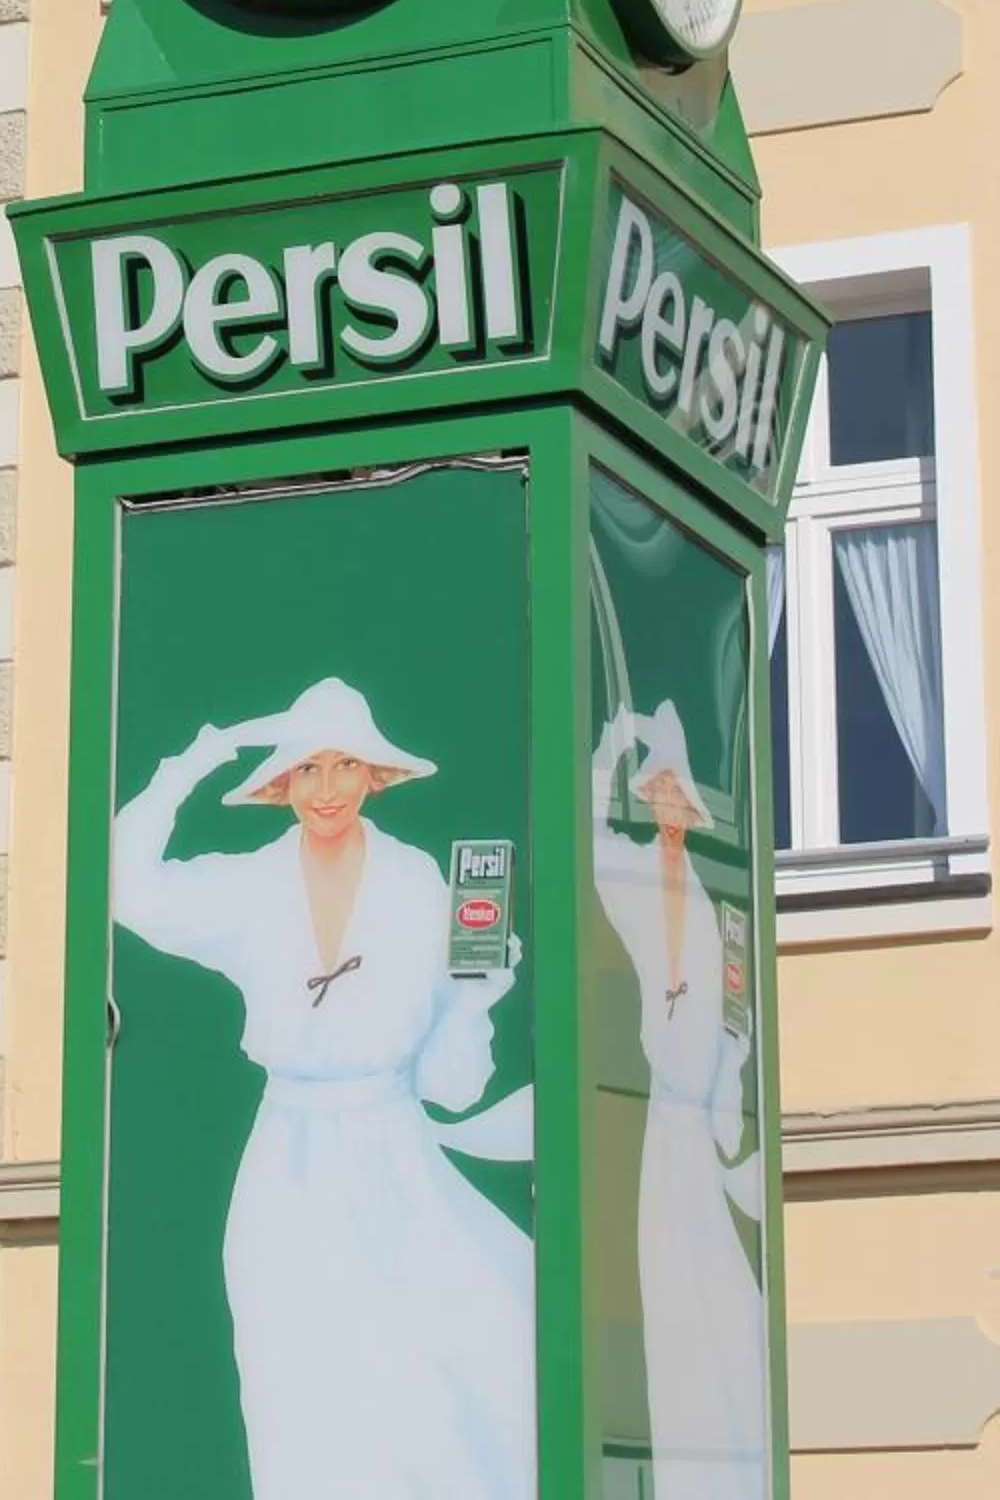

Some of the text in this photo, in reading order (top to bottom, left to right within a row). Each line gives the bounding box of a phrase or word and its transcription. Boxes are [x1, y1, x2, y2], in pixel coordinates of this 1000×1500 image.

[90, 182, 524, 393] Persil
[598, 196, 786, 470] Persil
[458, 847, 505, 885] Persil
